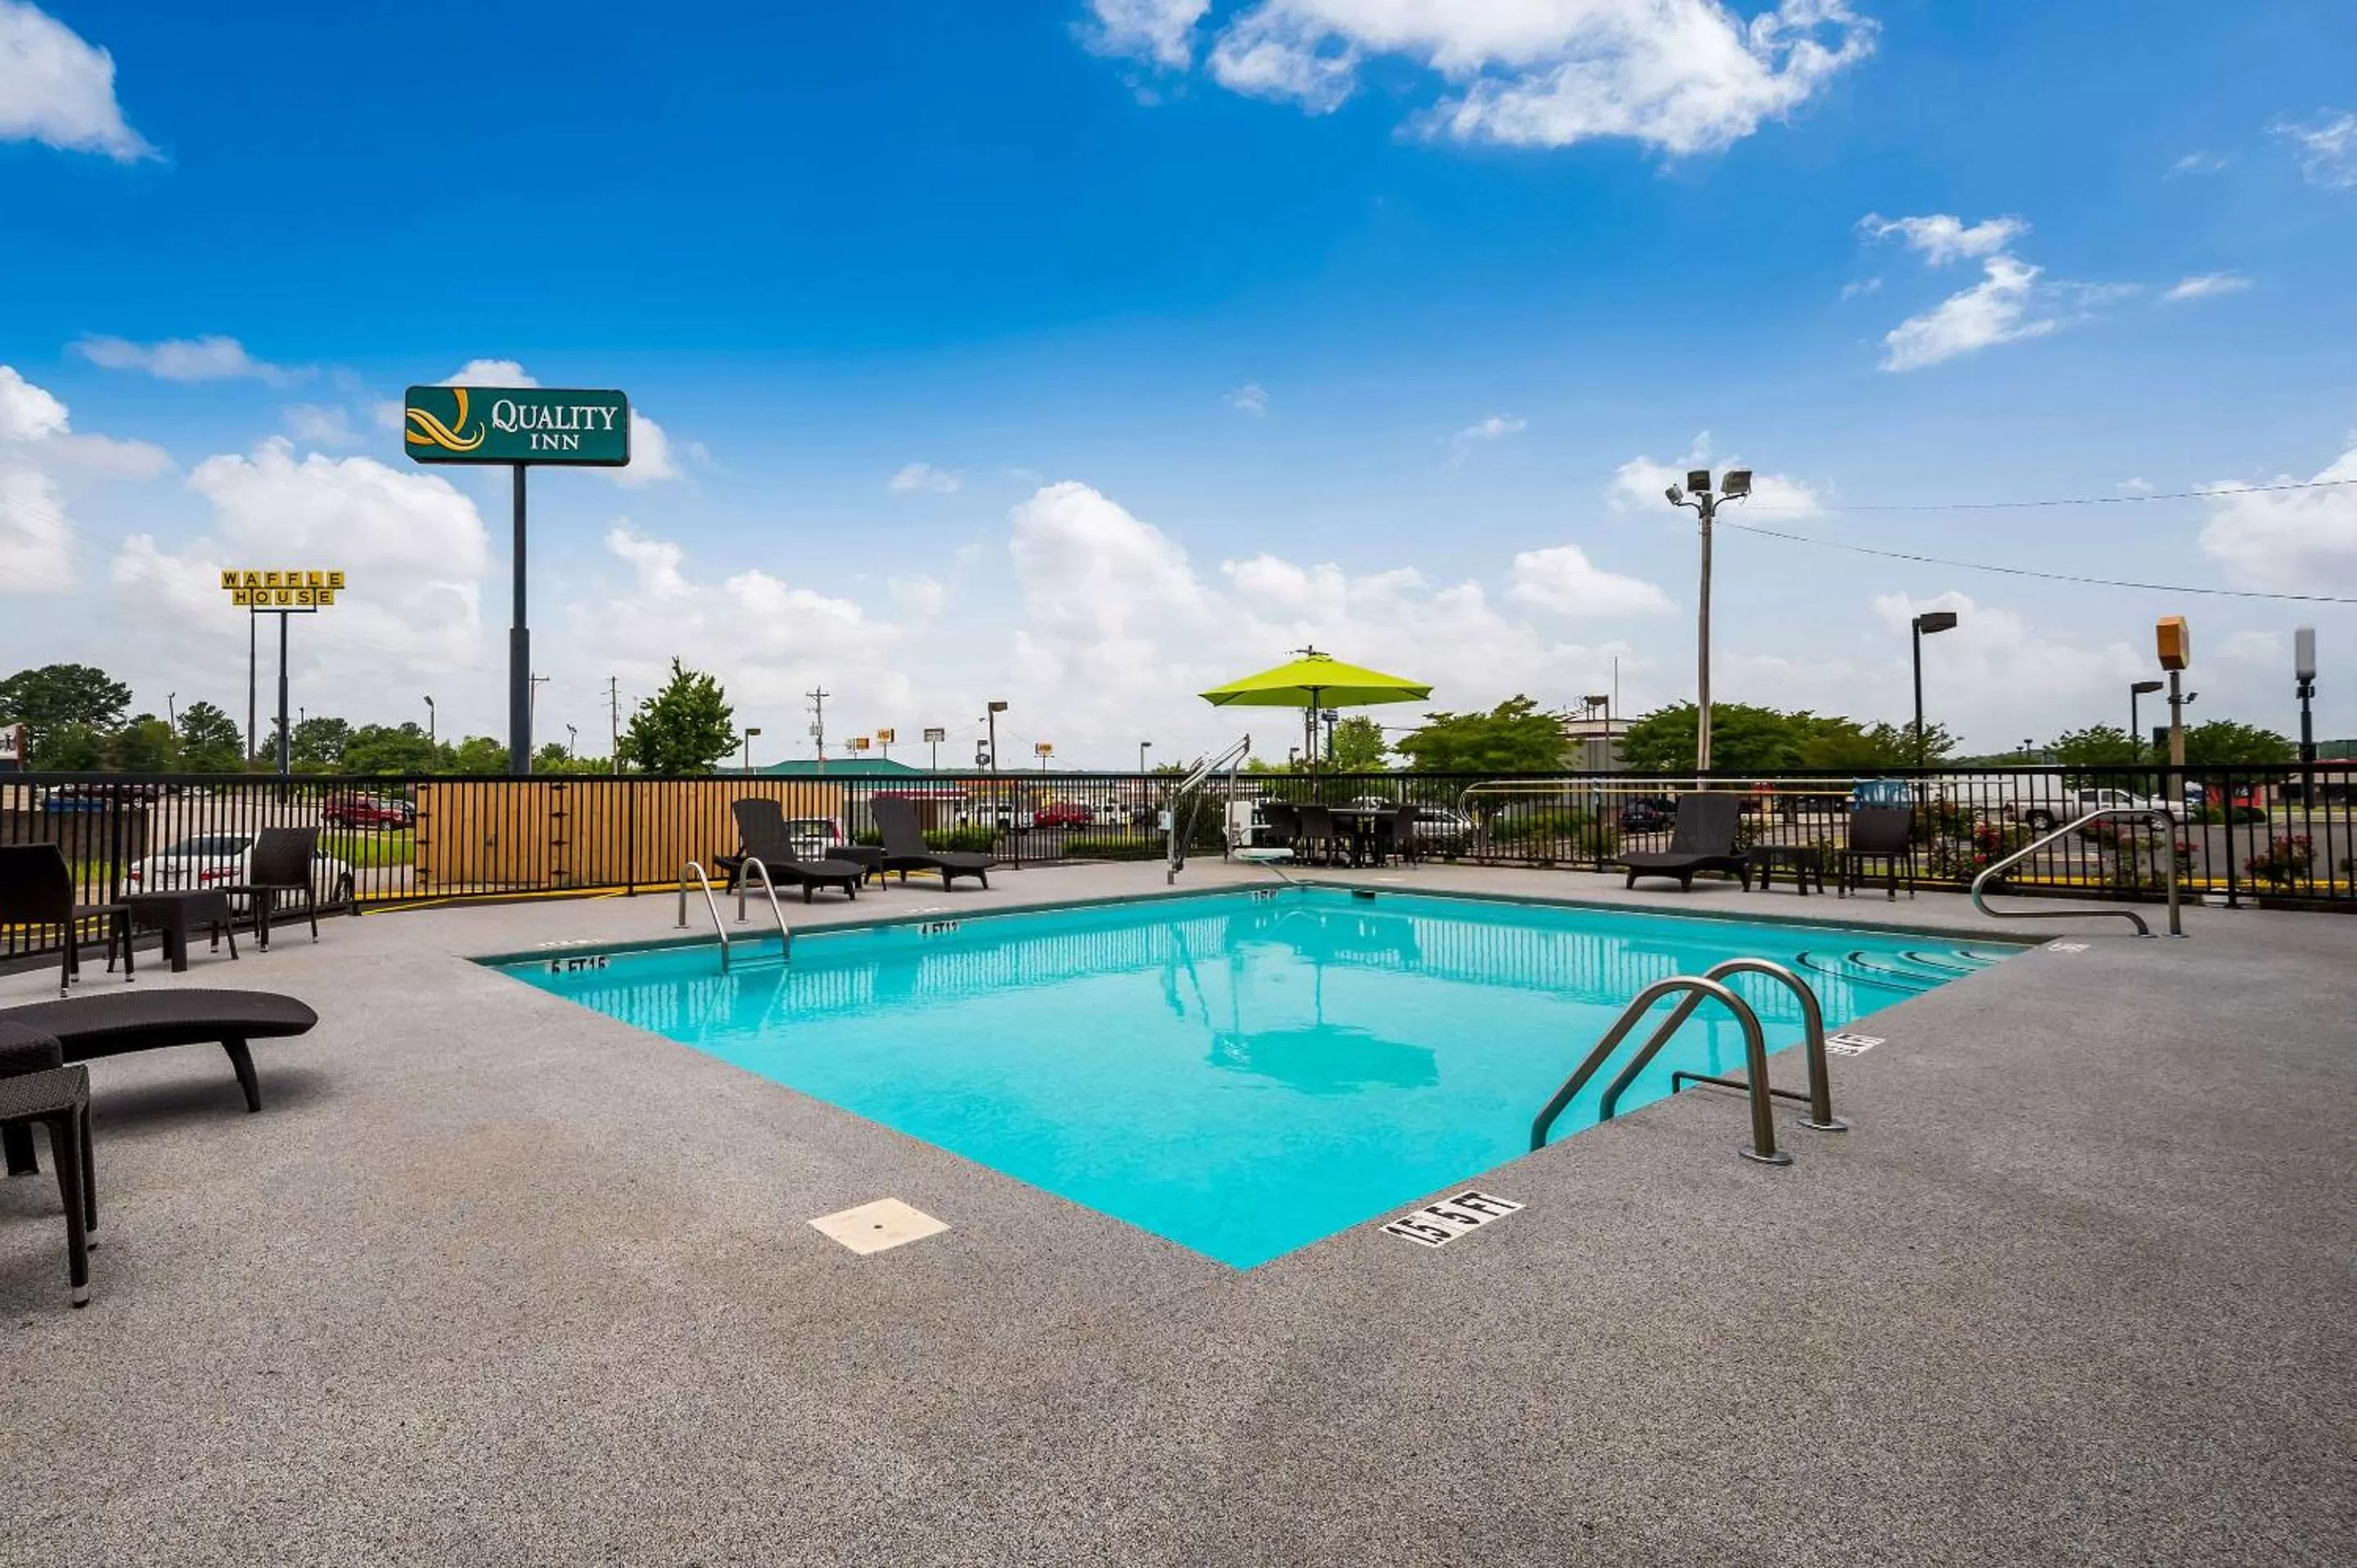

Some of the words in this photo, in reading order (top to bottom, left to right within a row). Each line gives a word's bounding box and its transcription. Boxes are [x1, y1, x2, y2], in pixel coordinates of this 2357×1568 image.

[492, 399, 618, 432] QUALITY
[530, 434, 579, 450] INN
[223, 572, 341, 585] WAFFLE
[235, 590, 331, 602] HOUSE
[1449, 1192, 1517, 1217] FT
